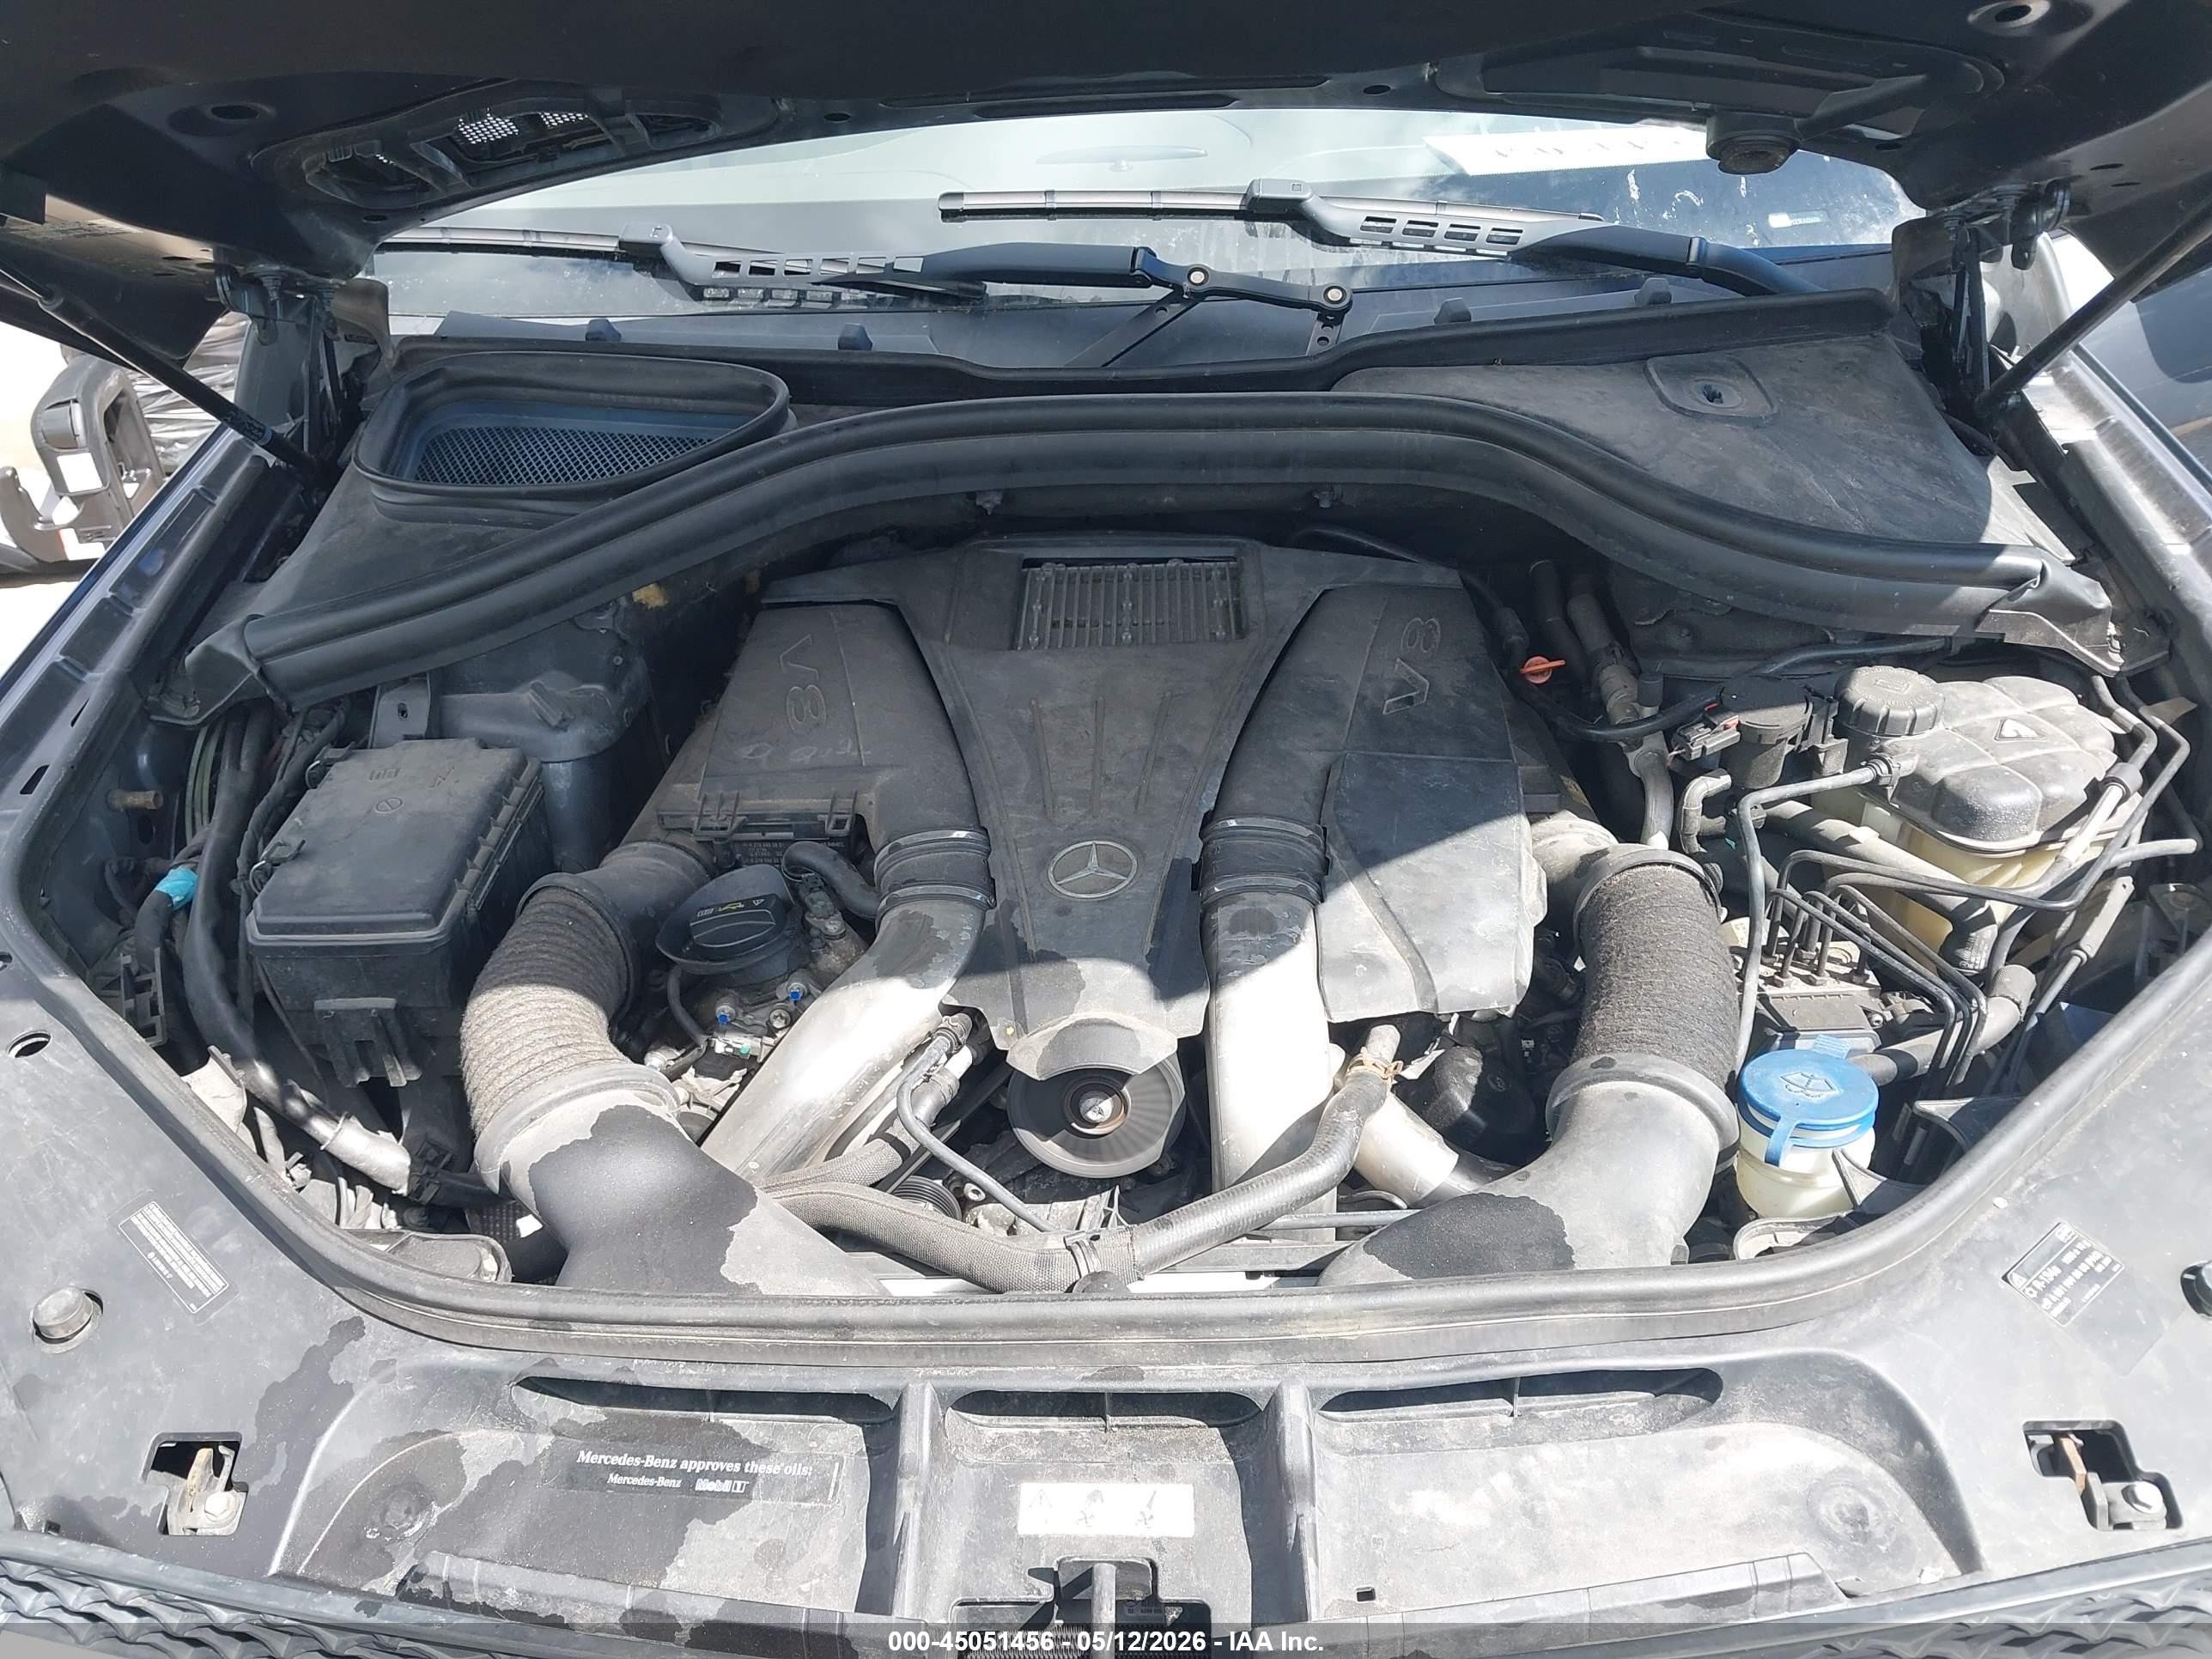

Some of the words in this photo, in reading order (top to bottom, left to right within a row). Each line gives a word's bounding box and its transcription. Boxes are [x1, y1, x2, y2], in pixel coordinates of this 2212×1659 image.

[779, 634, 827, 734] V8
[1382, 617, 1442, 715] V8
[576, 1449, 678, 1469] Mercedes-Benz
[679, 1459, 741, 1474] approves
[744, 1460, 782, 1475] these
[783, 1462, 813, 1477] oils:
[606, 1473, 683, 1488] Mercedes-Benz
[695, 1478, 732, 1492] Mobil
